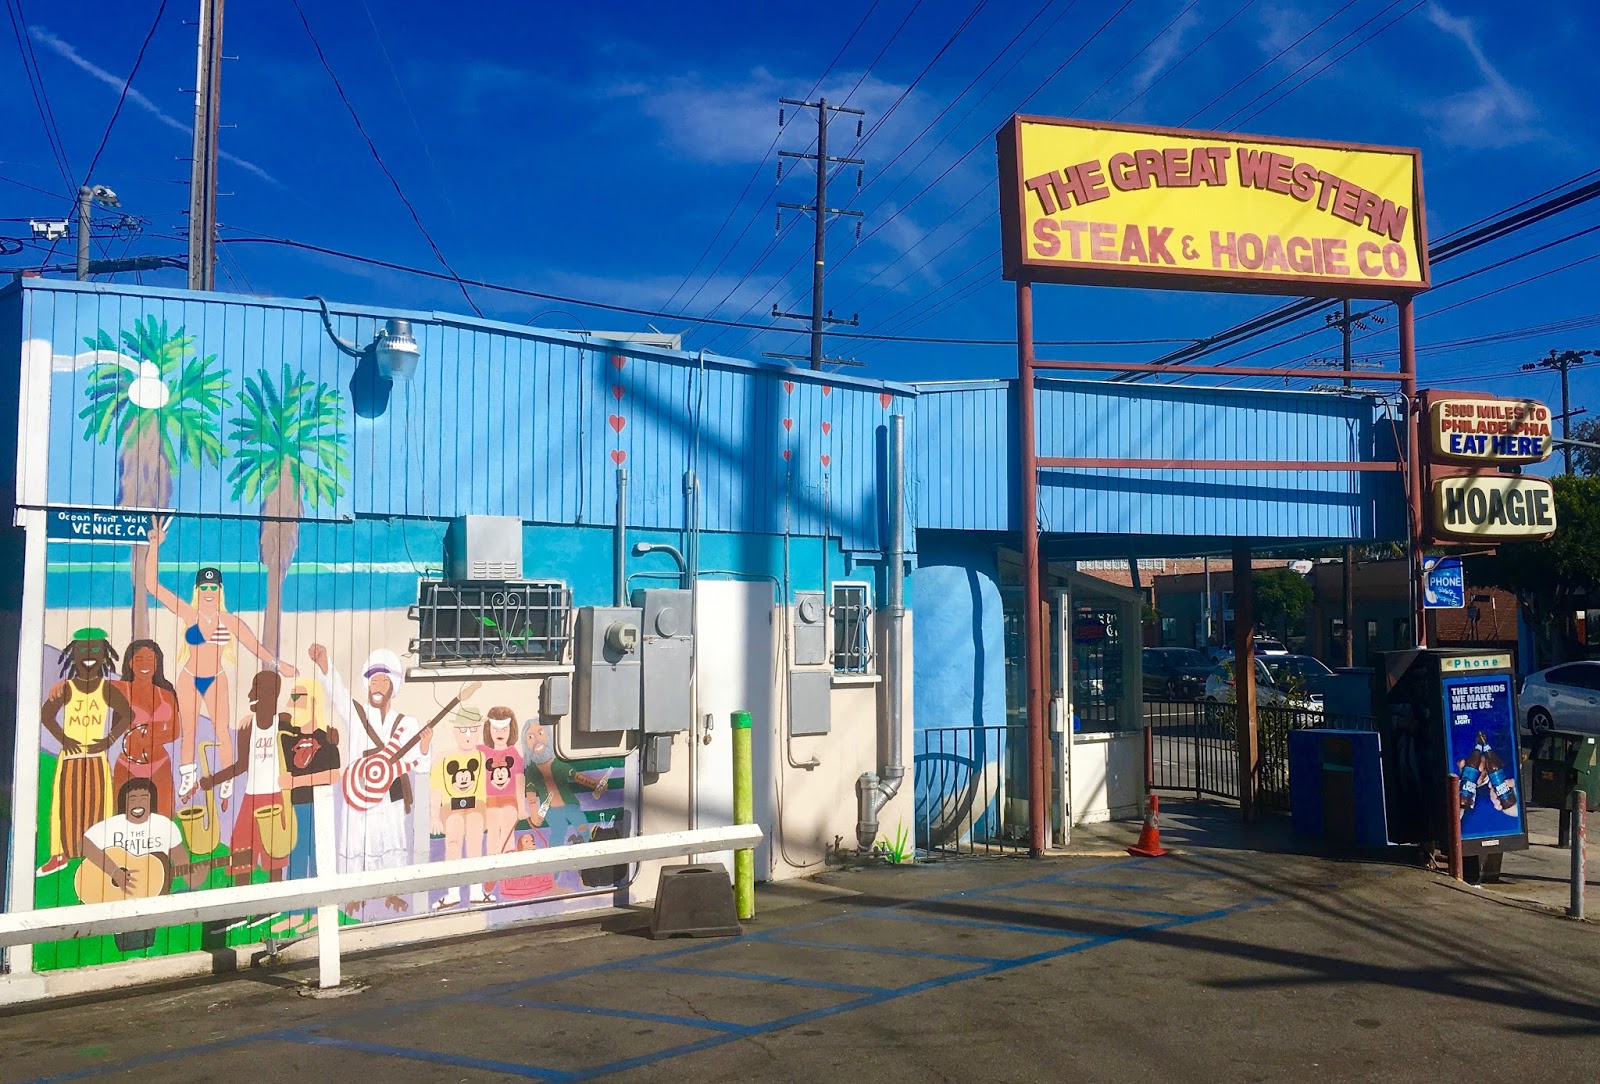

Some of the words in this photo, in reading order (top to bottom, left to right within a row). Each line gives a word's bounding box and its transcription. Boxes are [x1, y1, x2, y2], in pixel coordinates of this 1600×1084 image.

[1025, 159, 1111, 216] THE
[1108, 146, 1232, 192] GREAT
[1236, 147, 1409, 243] WESTERN
[1032, 217, 1177, 265] STEAK
[1181, 235, 1201, 260] &
[1209, 230, 1351, 276] HOAGIE
[1357, 241, 1409, 278] CO
[1444, 403, 1475, 418] 3000
[1476, 405, 1524, 419] MILES
[1528, 407, 1547, 421] TO
[1441, 418, 1551, 437] PHILADELPHIA
[1449, 433, 1488, 454] EAT
[1491, 435, 1544, 456] HERE
[1445, 487, 1553, 526] HOAGIE
[58, 511, 91, 522] Ocean
[1430, 576, 1462, 587] PHONE
[1454, 658, 1499, 669] Phone
[1451, 687, 1469, 696] THE
[1469, 684, 1506, 694] FRIENDS
[1452, 695, 1466, 704] WE
[1467, 693, 1495, 702] MAKE,
[1452, 702, 1478, 712] MAKE
[1479, 701, 1493, 710] US.
[69, 714, 102, 727] MON
[130, 830, 146, 838] THE
[113, 831, 163, 856] BEATLES
